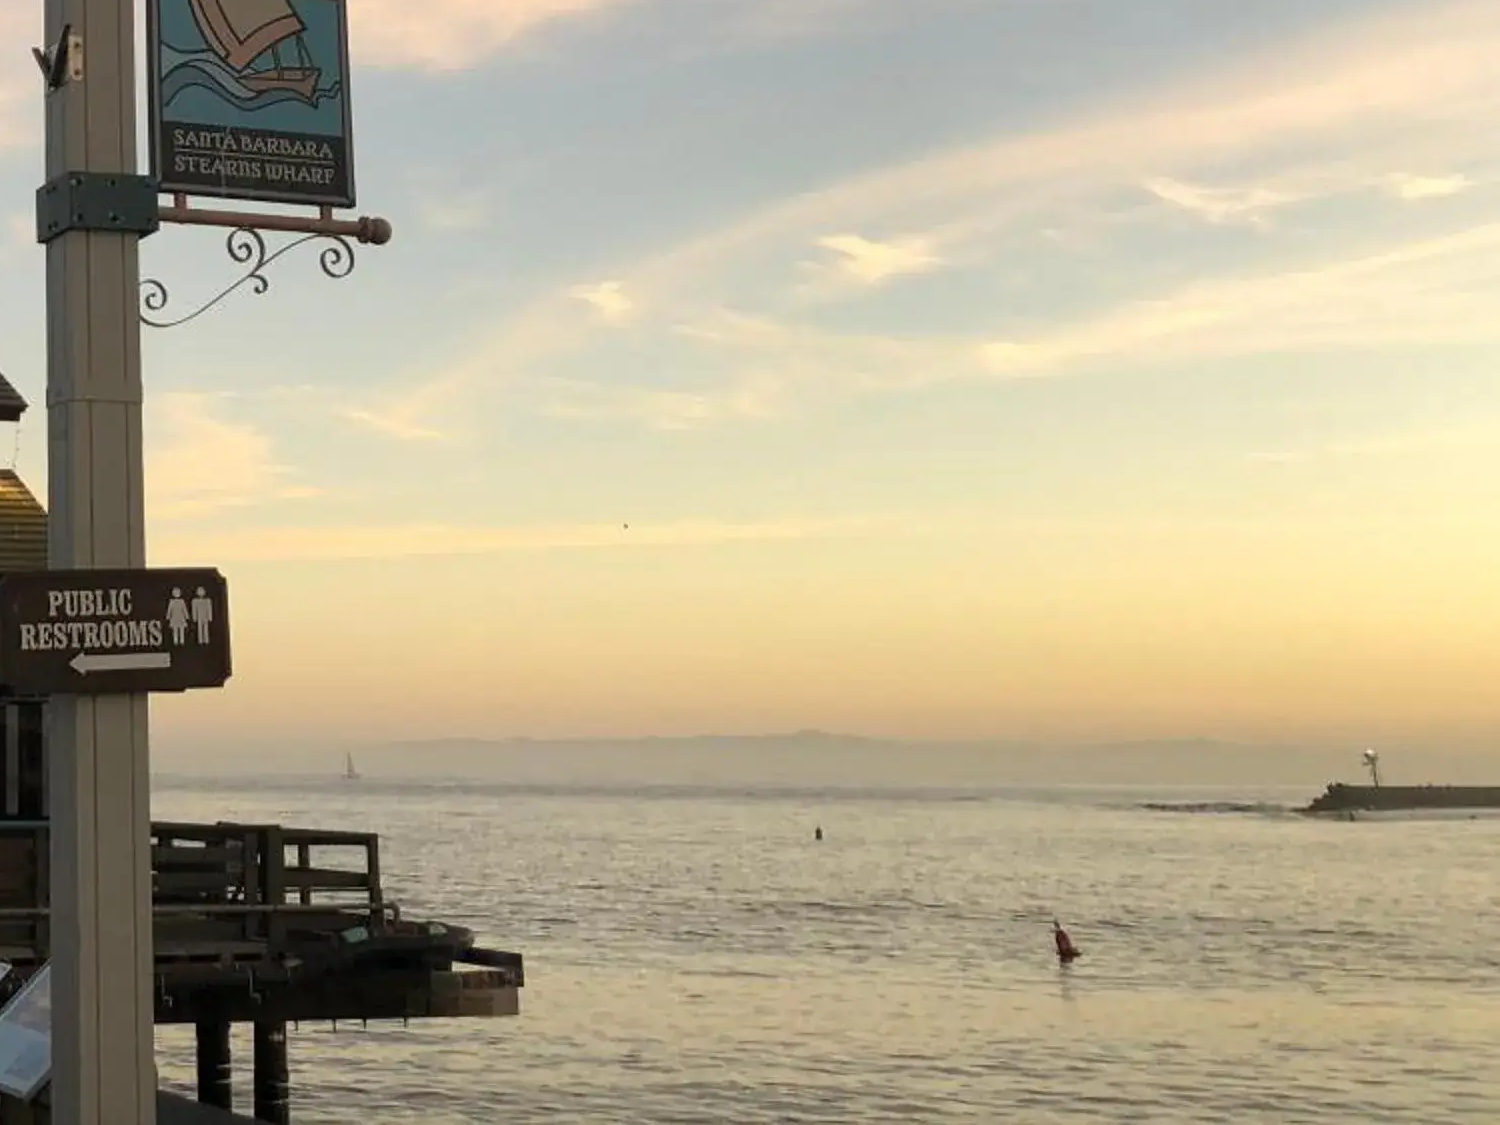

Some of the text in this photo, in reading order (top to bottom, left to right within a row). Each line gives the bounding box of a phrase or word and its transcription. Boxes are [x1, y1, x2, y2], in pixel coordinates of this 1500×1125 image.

[173, 128, 333, 159] SANTA BARBARA
[174, 154, 336, 185] STEARNS WHARF
[48, 588, 133, 617] PUBLIC
[19, 620, 163, 651] RESTROOMS
